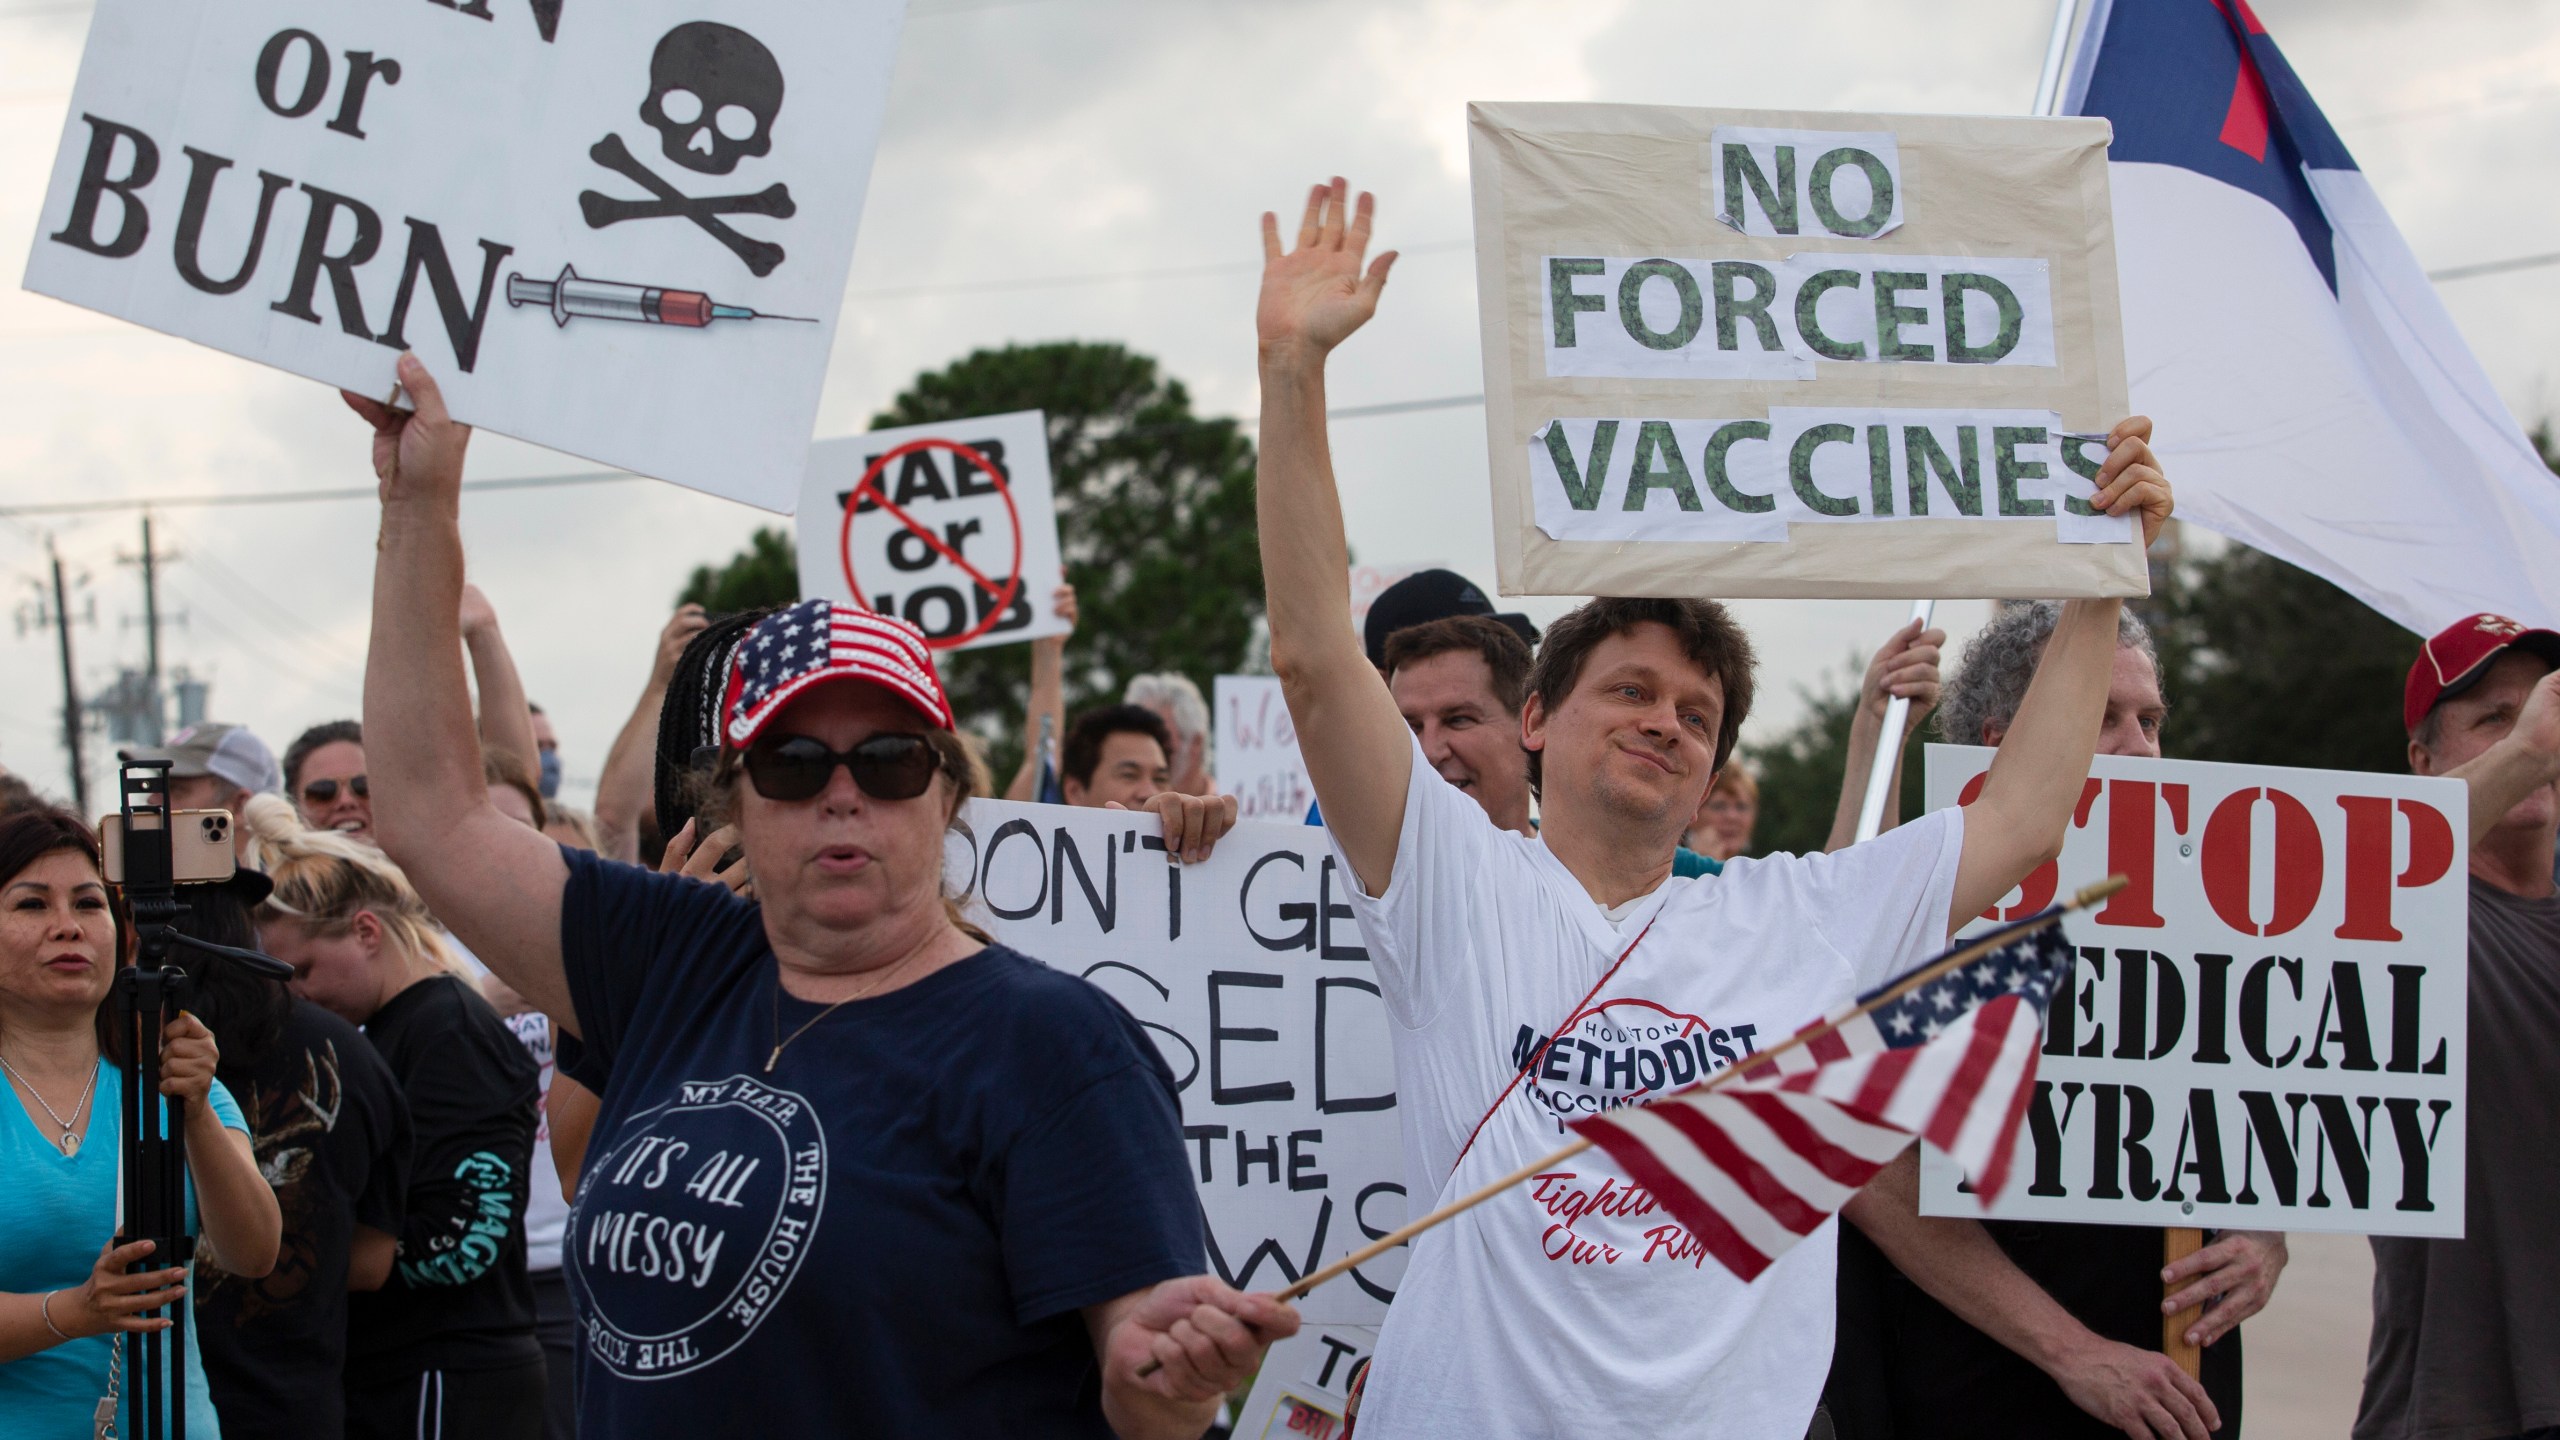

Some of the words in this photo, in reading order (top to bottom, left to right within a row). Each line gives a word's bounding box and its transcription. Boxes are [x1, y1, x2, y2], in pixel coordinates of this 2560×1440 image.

[254, 27, 402, 140] or
[1720, 142, 1895, 238] NO
[50, 112, 514, 374] BURN
[1548, 256, 2026, 365] FORCED
[836, 438, 1011, 515] JAB
[1545, 419, 2112, 518] VACCINES
[885, 517, 982, 573] or
[873, 576, 1034, 640] OB
[1955, 939, 2448, 1076] EDICAL
[1511, 1022, 1758, 1091] METHODIST
[681, 1084, 731, 1104] MY
[611, 1135, 690, 1190] IT'S
[684, 1150, 761, 1209] ALL
[790, 1141, 821, 1207] THE
[1183, 1125, 1328, 1192] THE
[1956, 1080, 2453, 1213] YRANNY
[587, 1210, 726, 1289] MESSY
[1541, 1223, 1625, 1266] Our
[636, 1336, 700, 1370] THE
[1286, 1404, 1337, 1440] Bill
